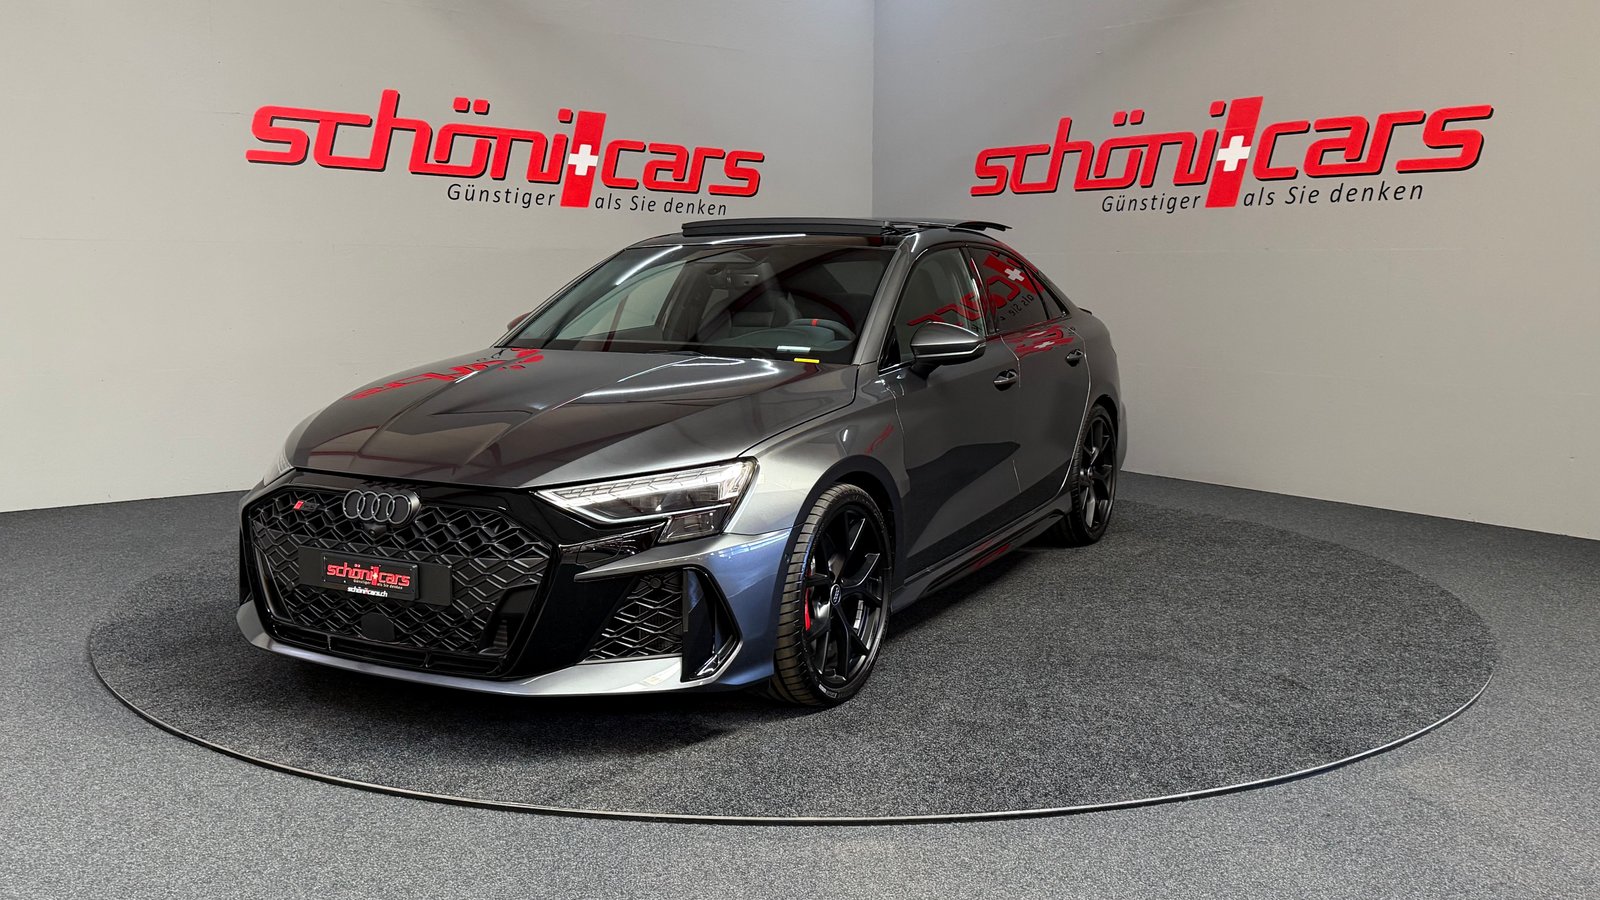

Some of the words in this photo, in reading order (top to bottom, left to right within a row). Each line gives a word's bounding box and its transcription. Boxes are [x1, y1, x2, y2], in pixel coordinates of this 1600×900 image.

[446, 183, 556, 209] Günstiger
[595, 193, 622, 210] als
[629, 194, 657, 213] Sie
[663, 197, 727, 216] denken
[1101, 192, 1201, 214] Günstiger
[1243, 186, 1275, 207] als
[1284, 184, 1318, 205] Sie
[1329, 180, 1424, 203] denken
